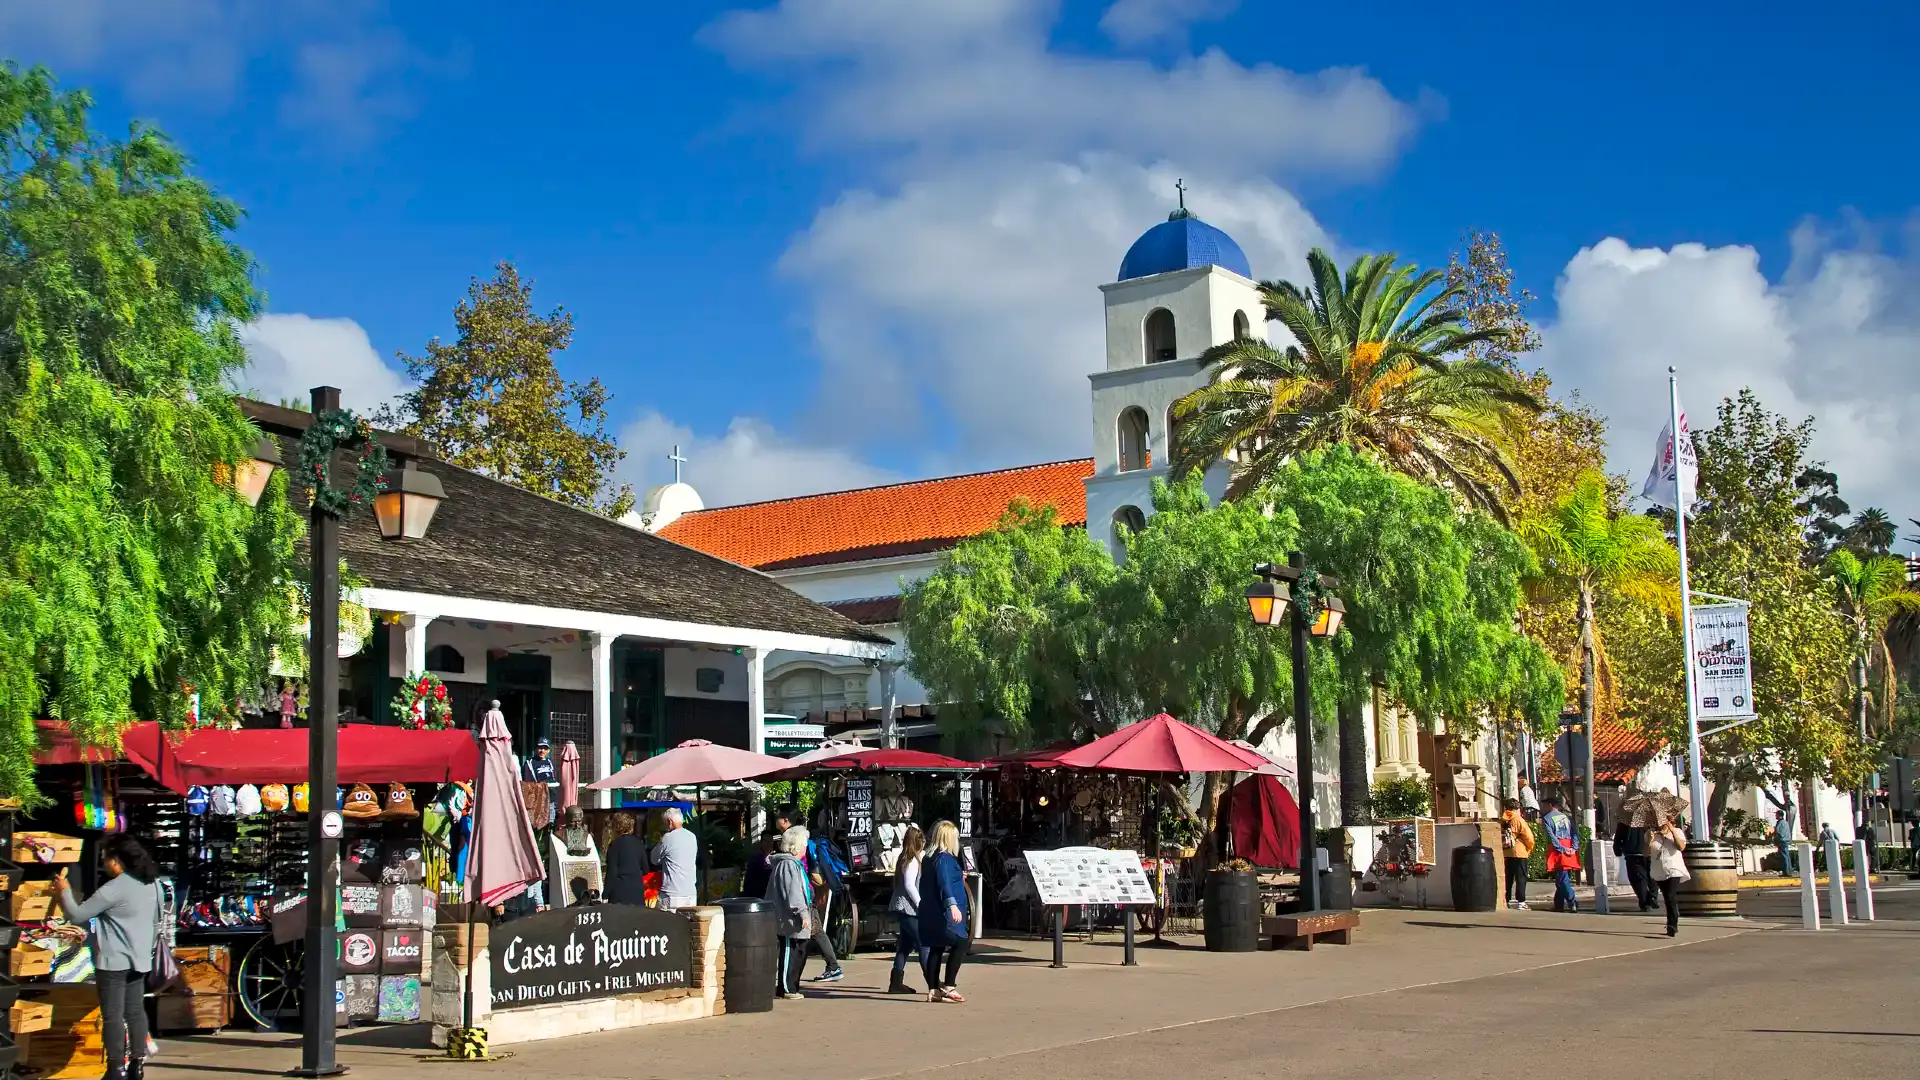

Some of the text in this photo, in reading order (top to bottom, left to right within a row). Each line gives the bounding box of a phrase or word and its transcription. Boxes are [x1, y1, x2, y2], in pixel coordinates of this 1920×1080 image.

[1695, 620, 1746, 630] Come Again.
[1700, 655, 1745, 668] OLD TOWN
[1704, 668, 1744, 677] SAN DIEGO
[770, 740, 786, 748] HOP
[789, 740, 800, 748] ON
[847, 789, 872, 801] GLASS
[847, 801, 872, 810] JEWELRY
[577, 912, 602, 926] 1853
[394, 936, 398, 946] I
[386, 945, 419, 957] TACOS
[503, 928, 669, 974] Casa de Aguirre
[490, 970, 684, 1003] SAN DIEGO GIFTS FREE MUSEUM
